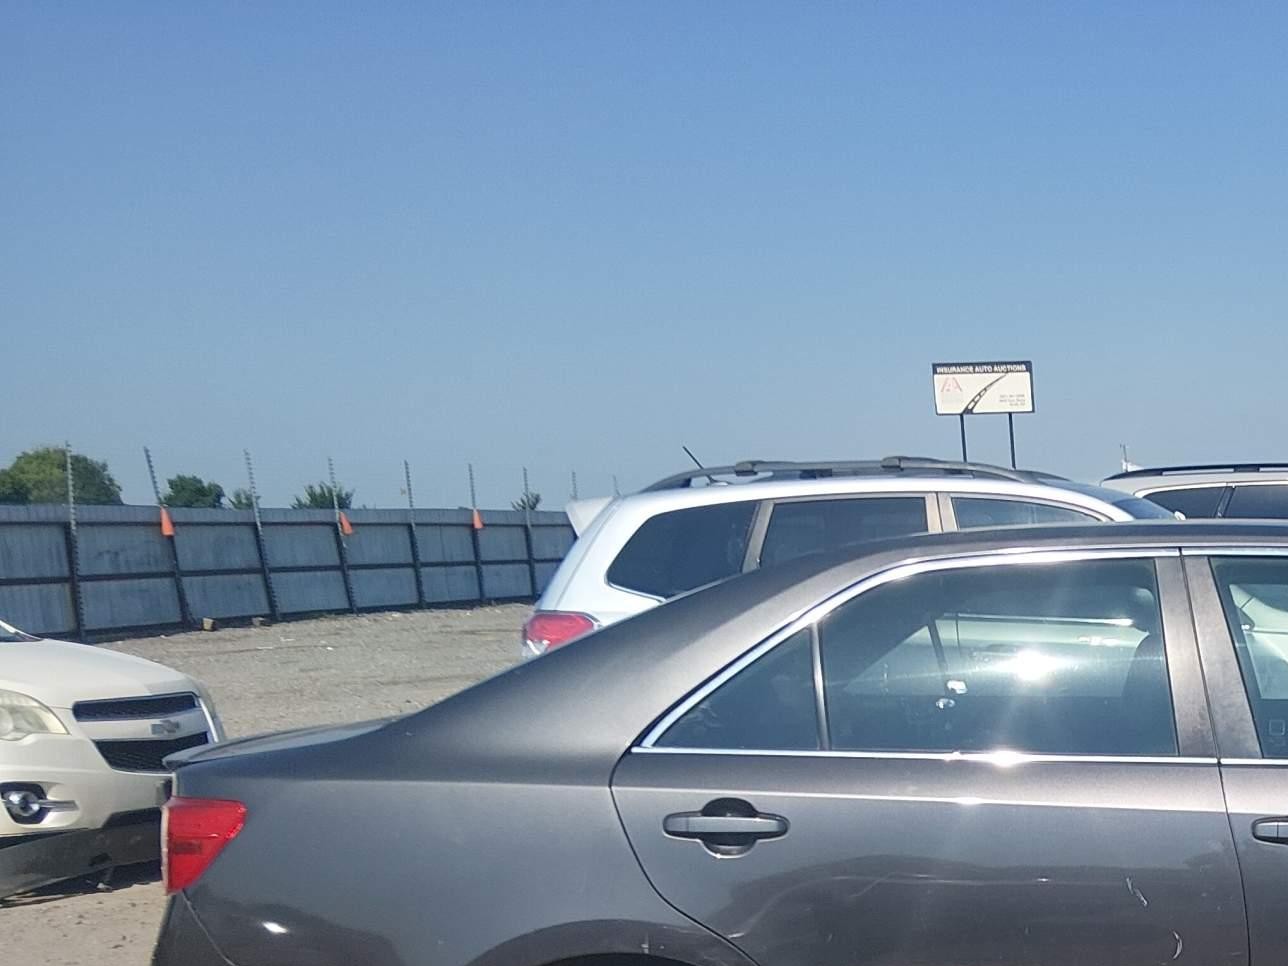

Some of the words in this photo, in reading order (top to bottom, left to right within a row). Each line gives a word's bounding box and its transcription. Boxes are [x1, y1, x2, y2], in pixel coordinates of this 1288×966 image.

[936, 366, 974, 374] INSURANCE
[974, 365, 993, 373] AUTO
[993, 364, 1027, 373] AUCTIONS
